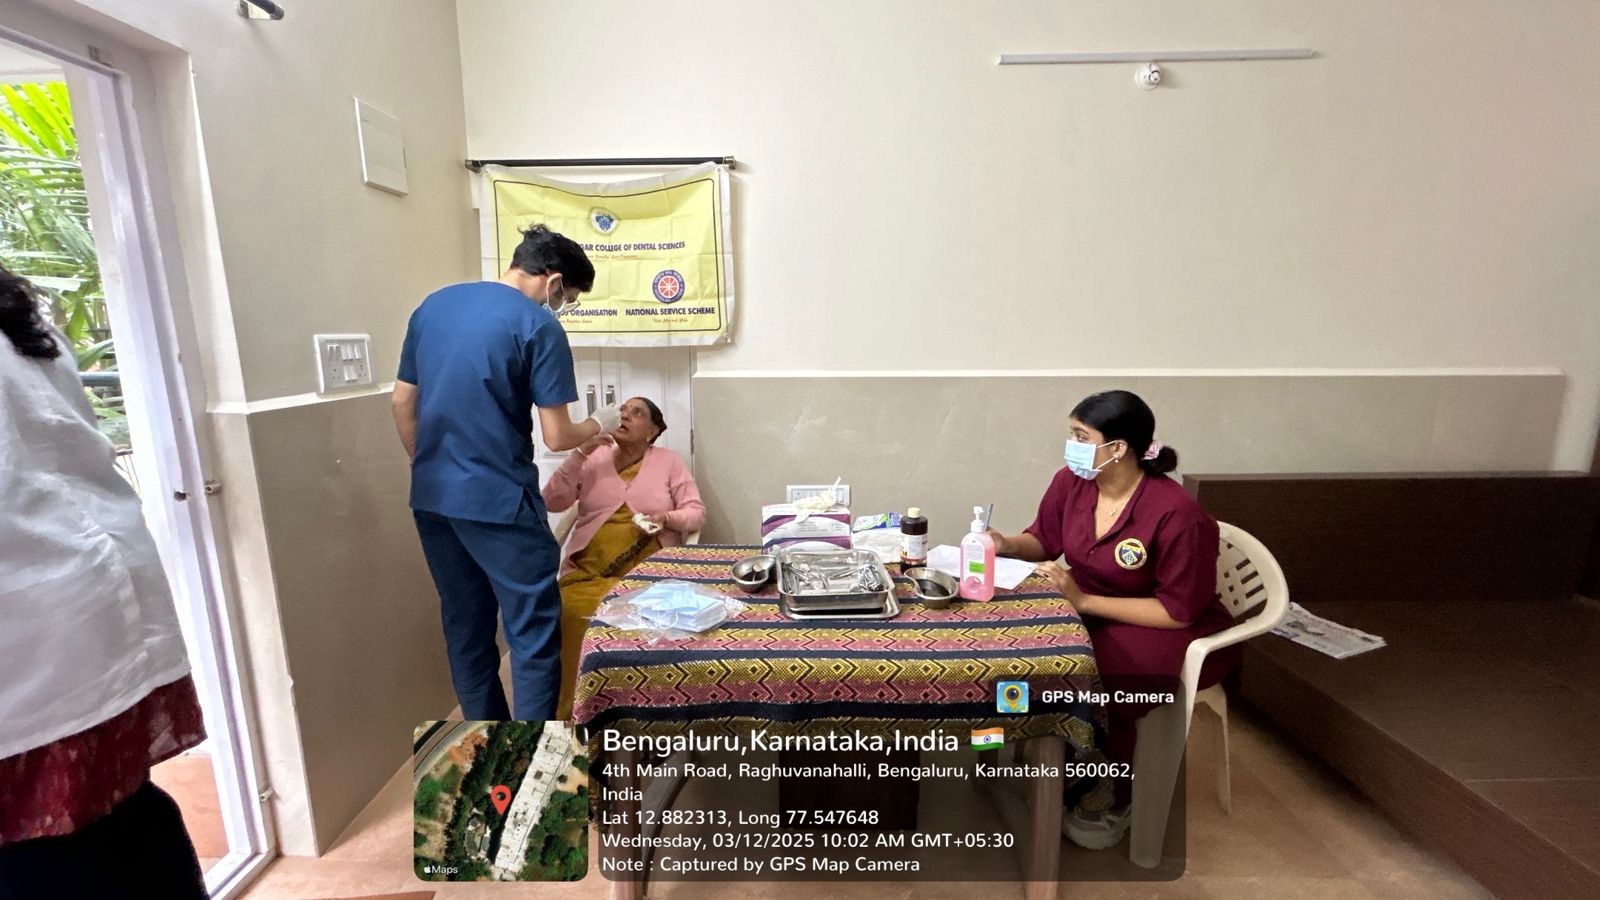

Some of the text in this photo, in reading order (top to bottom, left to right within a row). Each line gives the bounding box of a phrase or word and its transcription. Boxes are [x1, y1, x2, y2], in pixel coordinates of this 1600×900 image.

[580, 240, 685, 252] GAR COLLEGE OF DENTAL SCIENCES
[570, 309, 617, 317] ORGANISATION
[625, 308, 658, 317] NATIONAL
[688, 307, 715, 315] SCHEME
